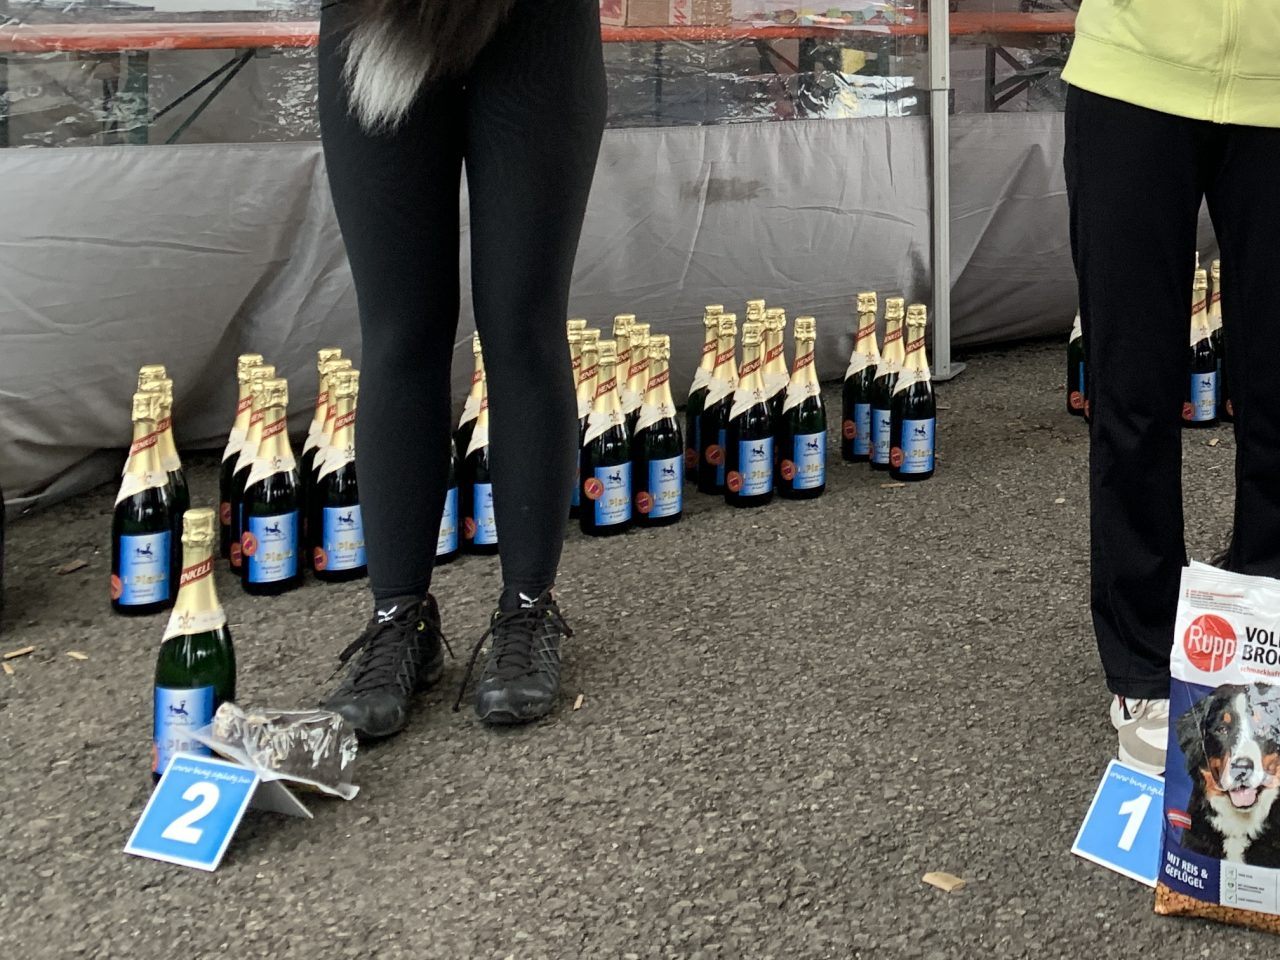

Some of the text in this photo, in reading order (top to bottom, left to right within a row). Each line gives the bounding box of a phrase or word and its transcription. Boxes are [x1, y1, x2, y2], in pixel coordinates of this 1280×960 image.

[1187, 624, 1236, 673] Rupp
[162, 781, 220, 845] 2
[1117, 793, 1153, 852] 1
[1165, 862, 1205, 890] GEFLÜGEL
[1166, 851, 1209, 879] MIT REIS &
